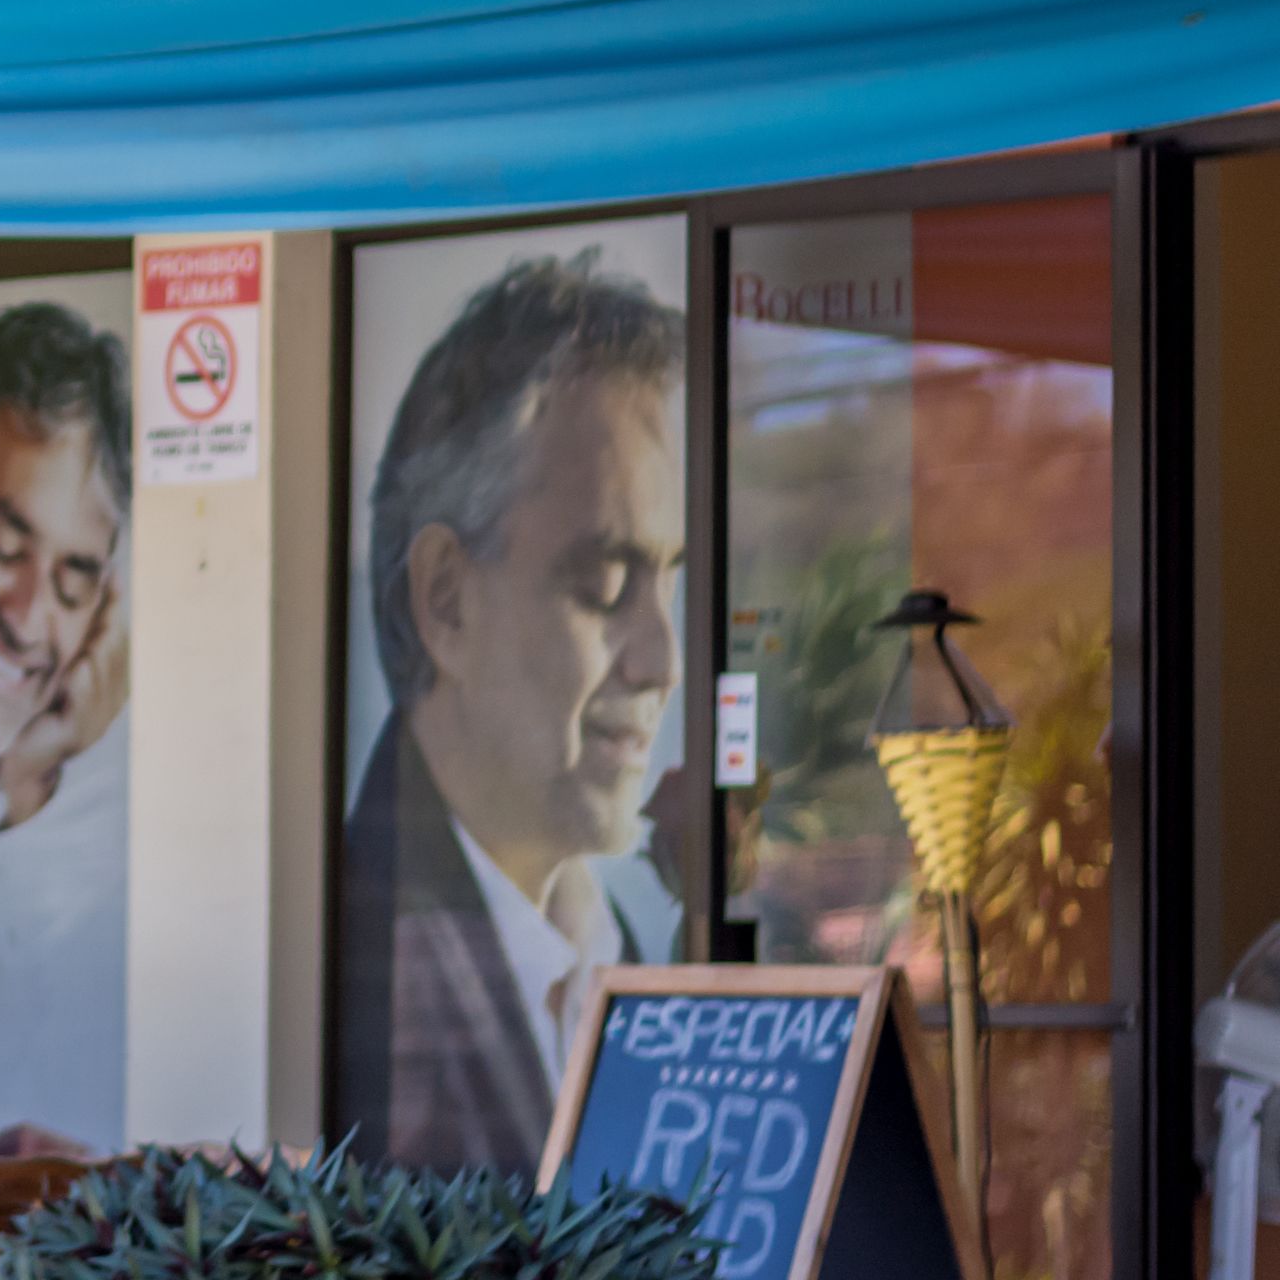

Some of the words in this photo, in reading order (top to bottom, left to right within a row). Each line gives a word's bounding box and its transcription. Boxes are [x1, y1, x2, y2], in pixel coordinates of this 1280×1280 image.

[146, 247, 257, 280] PROHIBIDO
[165, 277, 238, 307] FUMAR
[623, 996, 845, 1063] ESPECIAL
[629, 1089, 809, 1195] RED
